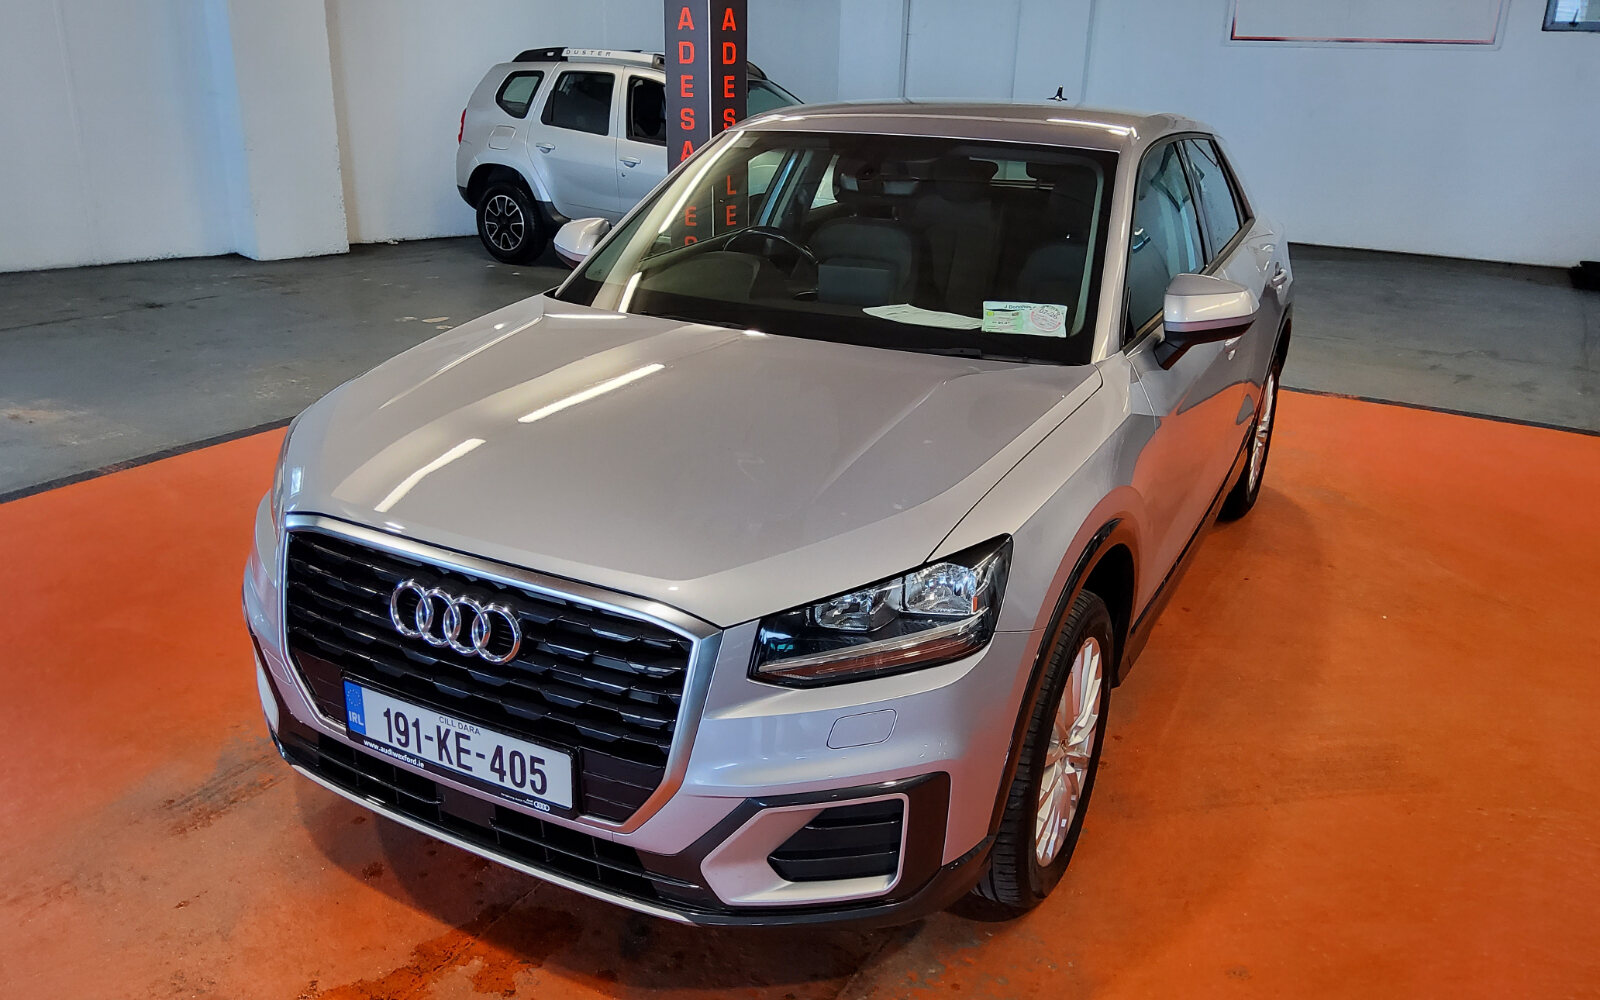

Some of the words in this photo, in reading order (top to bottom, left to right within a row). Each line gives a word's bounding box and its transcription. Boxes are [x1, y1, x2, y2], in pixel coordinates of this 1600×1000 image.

[348, 710, 364, 726] IRL
[438, 715, 457, 728] CILL
[457, 719, 481, 736] DARA
[383, 708, 548, 796] 191-KE-405
